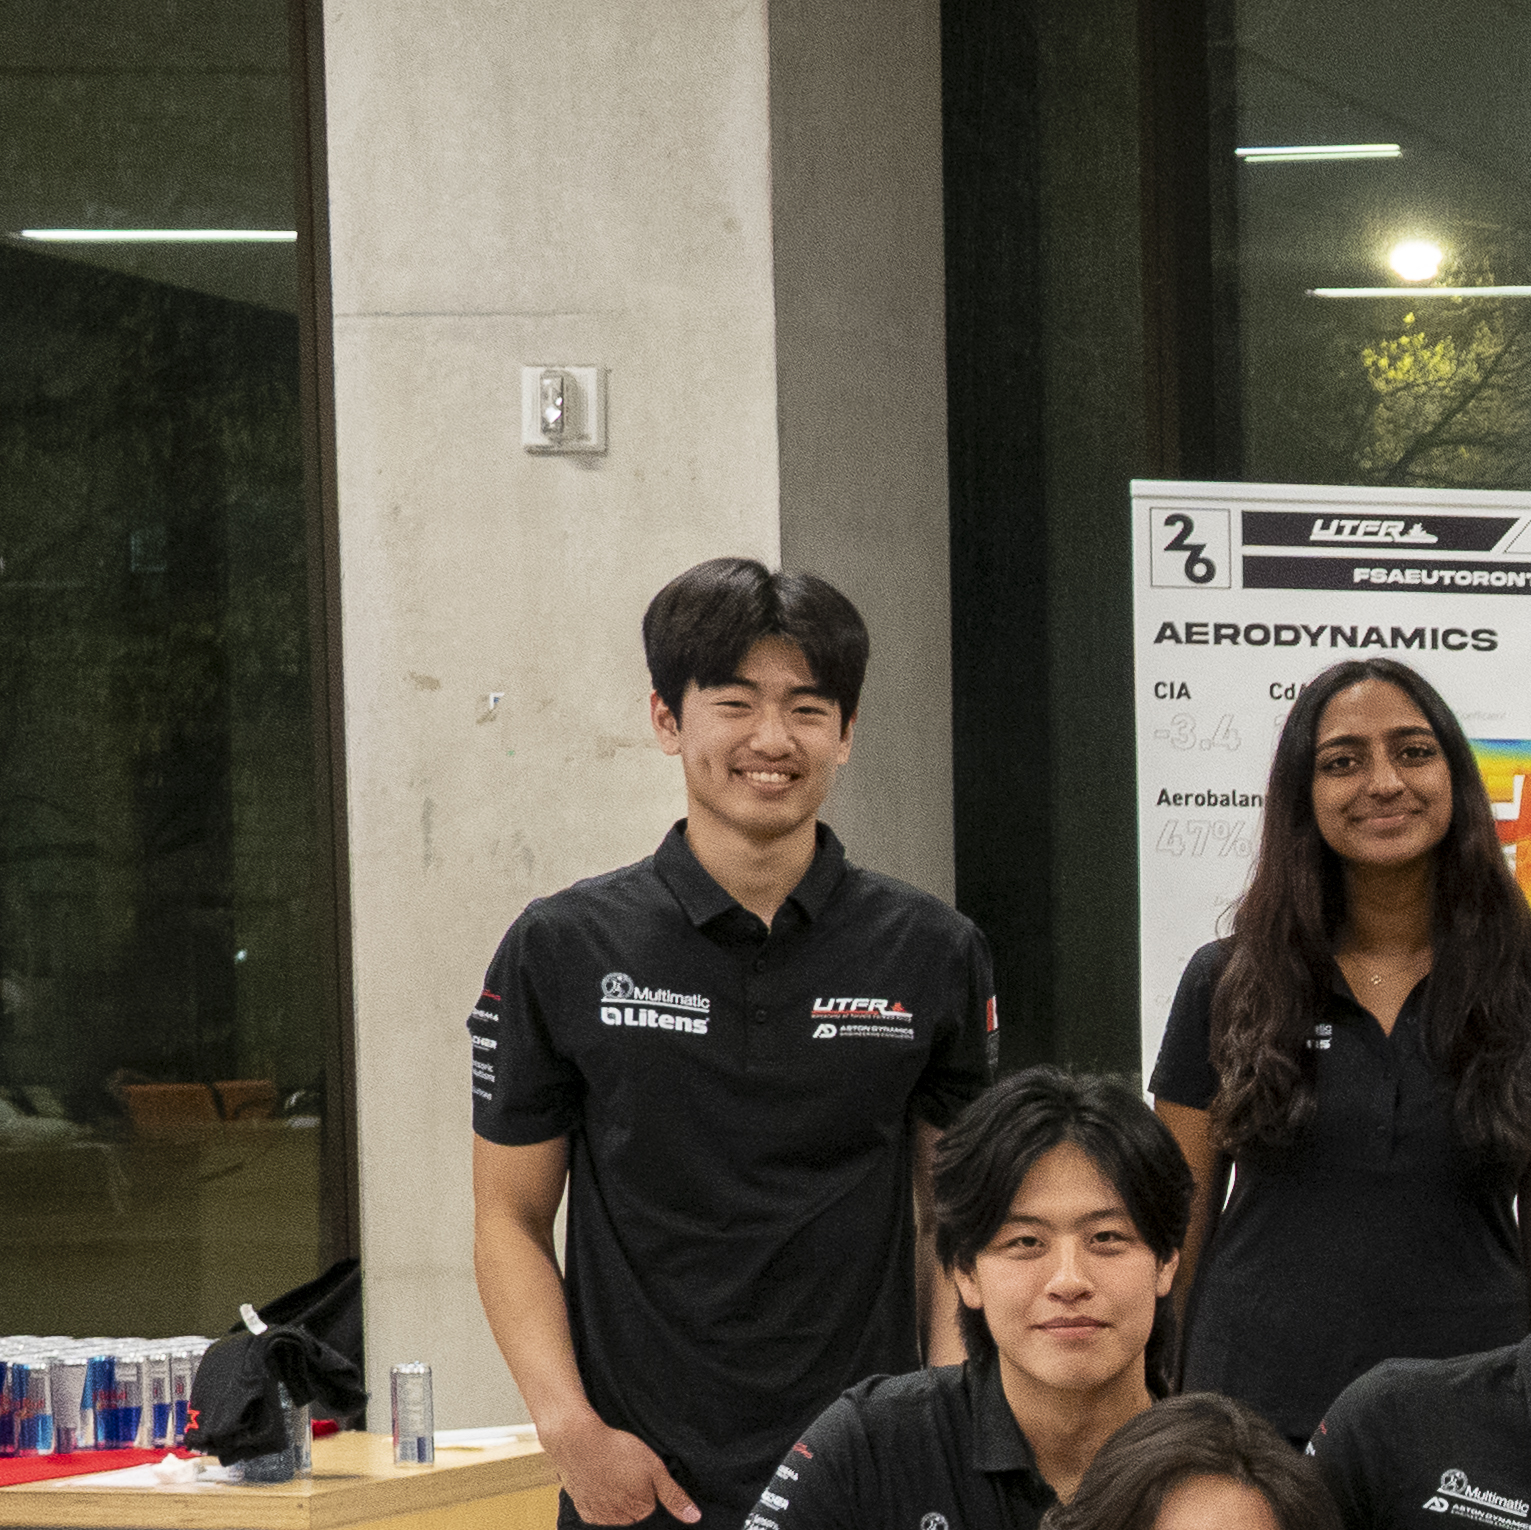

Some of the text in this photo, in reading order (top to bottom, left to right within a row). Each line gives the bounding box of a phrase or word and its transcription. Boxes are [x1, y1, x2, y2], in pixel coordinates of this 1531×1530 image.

[1154, 621, 1499, 652] AERODYNAMICS
[1155, 787, 1263, 808] Aerobalan
[633, 986, 711, 1010] Multimatic
[625, 1010, 709, 1035] Litens
[1464, 1485, 1530, 1514] Multimatic
